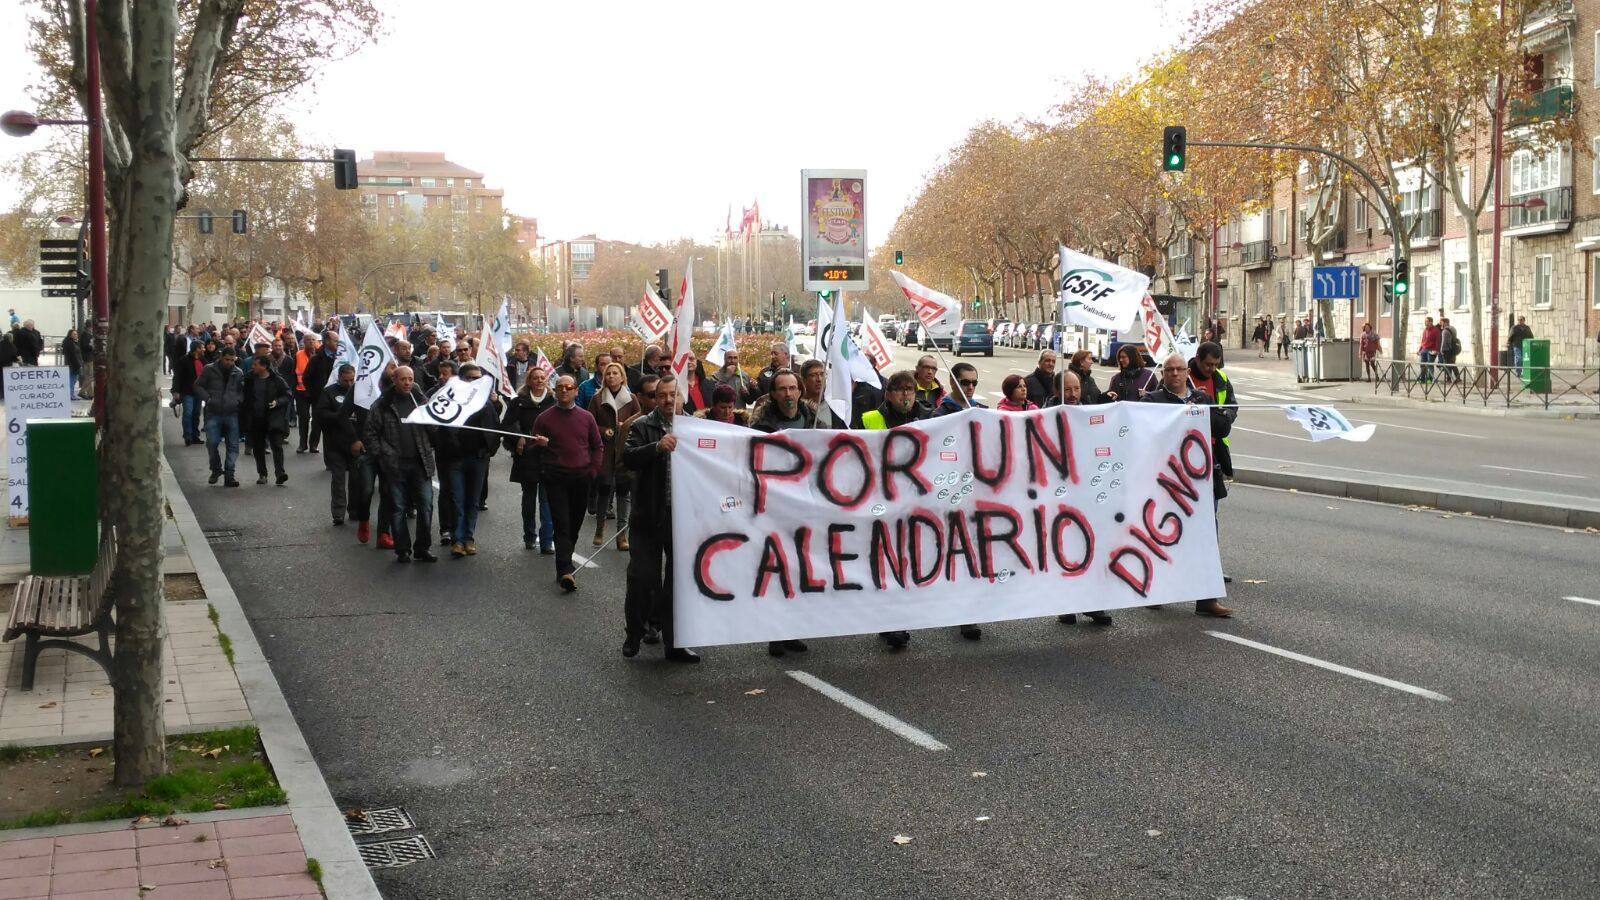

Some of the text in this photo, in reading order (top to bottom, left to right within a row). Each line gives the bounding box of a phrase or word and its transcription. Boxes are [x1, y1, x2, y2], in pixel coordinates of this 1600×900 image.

[1082, 303, 1116, 322] Valladolid
[11, 370, 61, 380] OFERTA
[8, 384, 34, 392] QUESO
[20, 402, 64, 410] PALENCIA
[749, 410, 1080, 517] POR UN
[1107, 428, 1213, 599] DIGNO
[693, 499, 1096, 602] CALENDARIO
